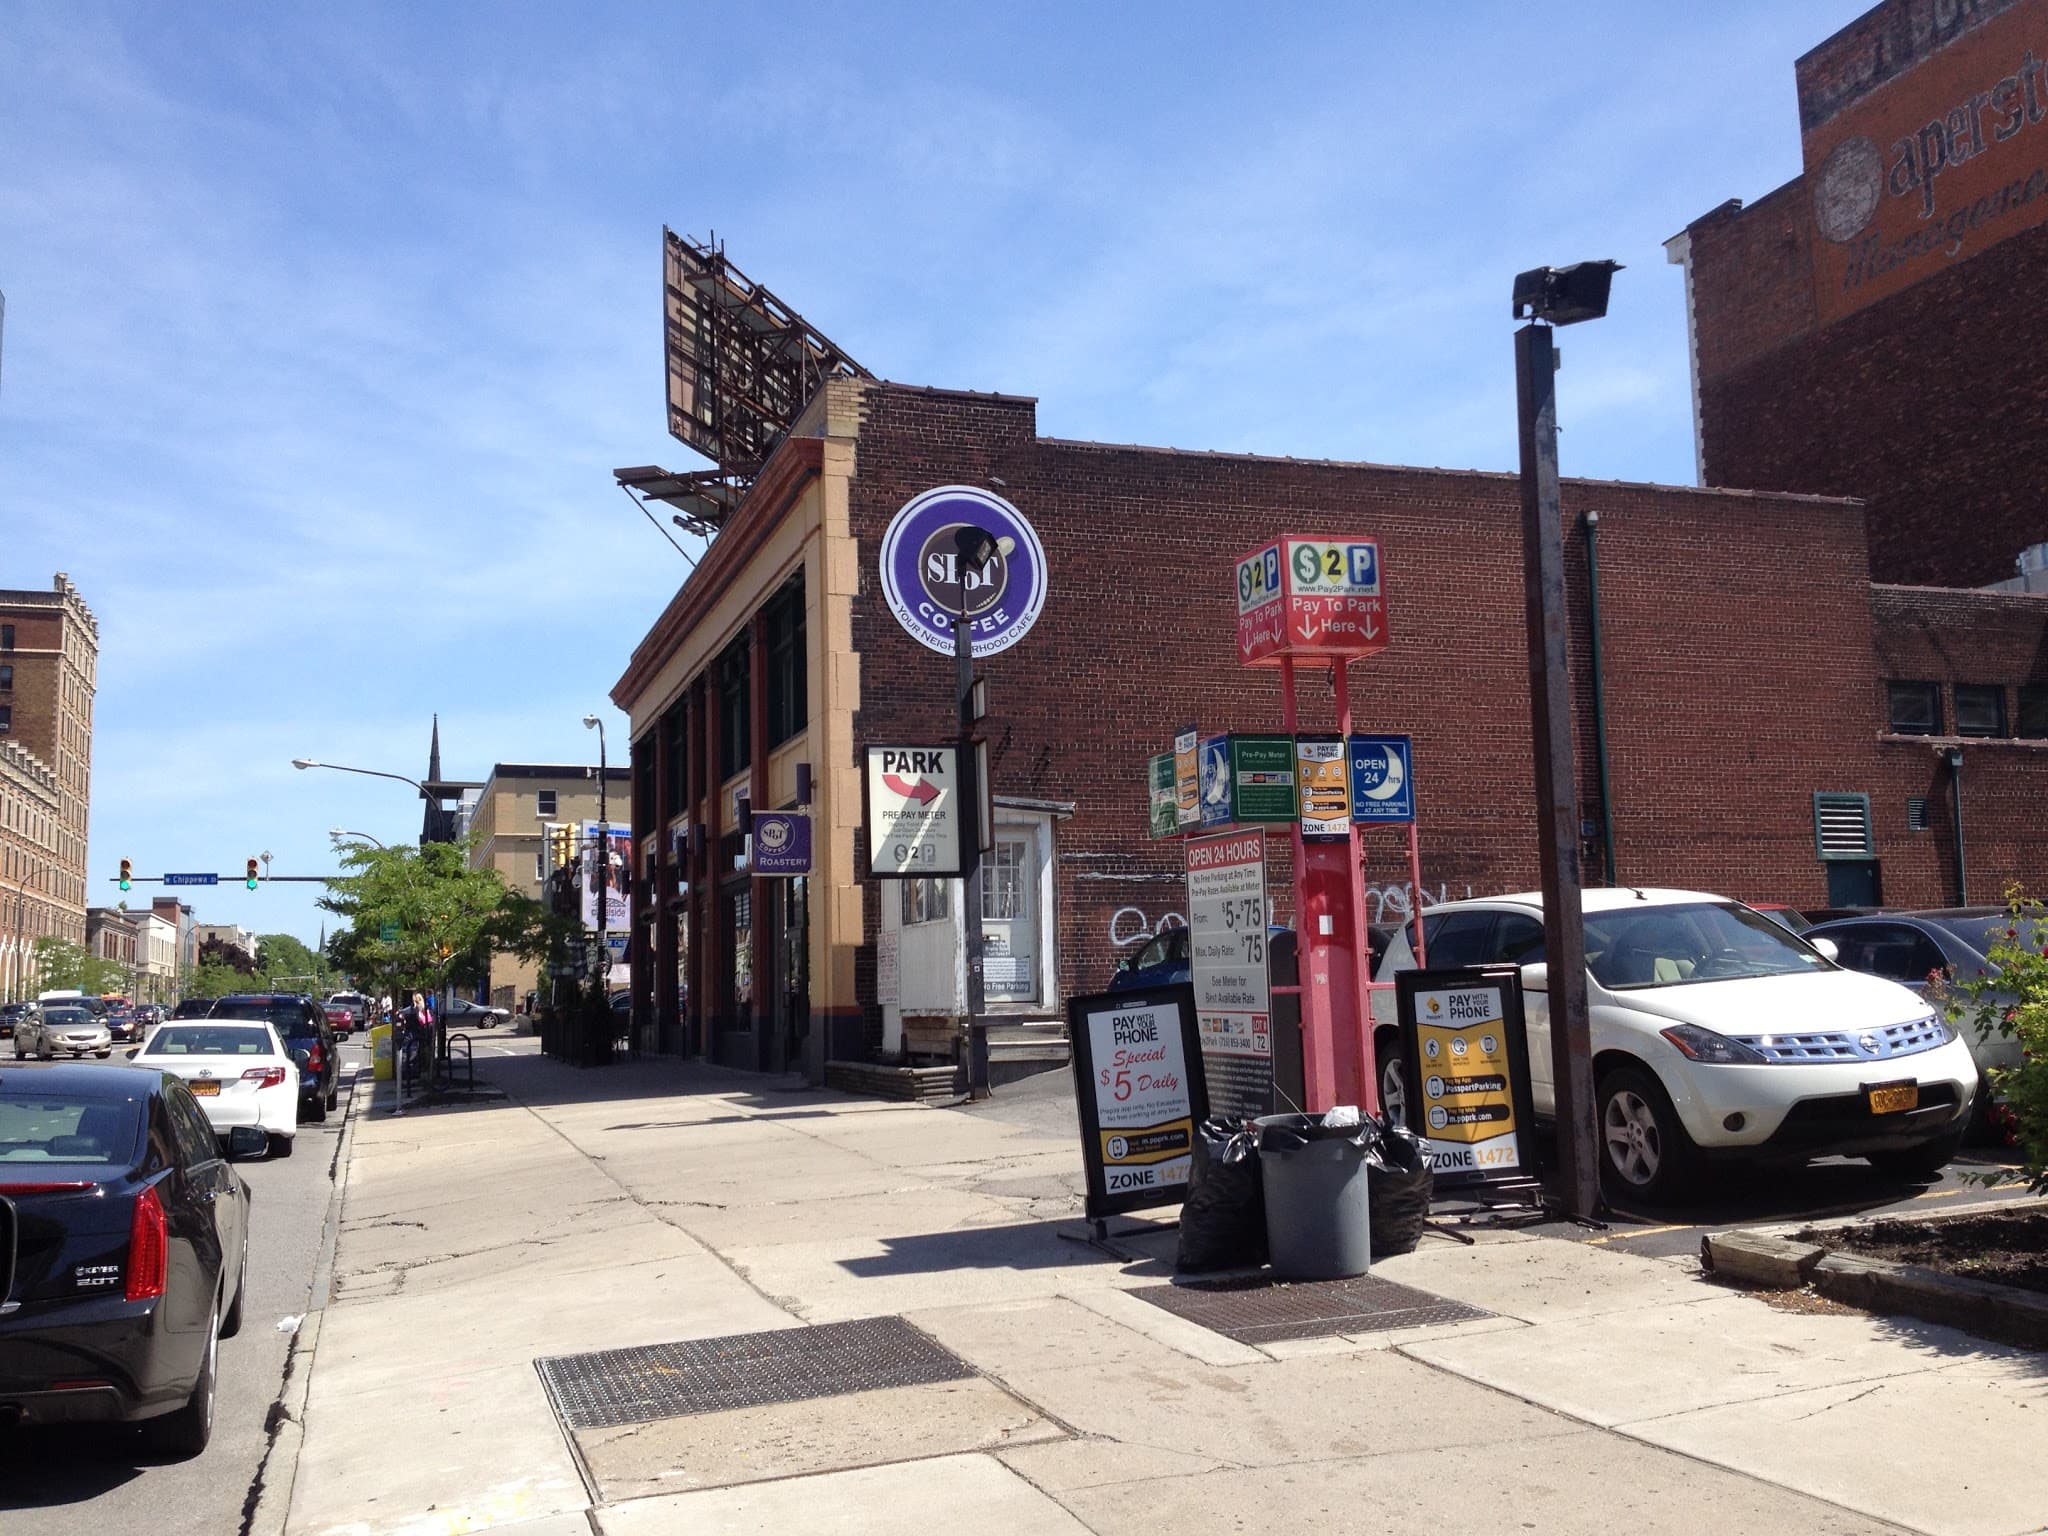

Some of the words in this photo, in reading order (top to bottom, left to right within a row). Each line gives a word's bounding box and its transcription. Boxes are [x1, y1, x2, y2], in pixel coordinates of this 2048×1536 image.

[1889, 50, 2048, 220] aperst
[1297, 584, 1375, 594] www.Pay2Park.net
[1292, 598, 1321, 615] Pay
[1325, 598, 1344, 612] To
[1347, 598, 1382, 612] Park
[1240, 616, 1253, 631] Pay
[1254, 610, 1264, 624] To
[1265, 600, 1283, 620] Park
[897, 605, 921, 634] YOUR
[920, 630, 1009, 654] NEIGHRHOOD
[1320, 618, 1356, 633] Here
[1253, 630, 1271, 646] Here
[882, 750, 945, 774] PARK
[1241, 751, 1267, 760] Pre-Pay
[1267, 751, 1286, 759] Meter
[1355, 759, 1387, 770] OPEN
[1364, 772, 1380, 784] 24
[1388, 775, 1401, 784] hrs
[882, 810, 900, 820] PRE
[901, 810, 917, 820] PAY
[917, 810, 947, 820] METER
[1303, 823, 1325, 833] ZONE
[1327, 823, 1347, 832] 1472
[1188, 846, 1213, 867] OPEN
[1214, 844, 1225, 864] 24
[1226, 839, 1260, 862] HOURS
[760, 857, 808, 866] ROASTERY
[172, 875, 208, 885] Chippewa
[1201, 874, 1210, 882] Free
[1210, 872, 1228, 882] Parking
[1234, 870, 1243, 880] Any
[1243, 868, 1257, 878] Time
[1246, 881, 1261, 891] Meter
[1207, 945, 1221, 959] Daily
[1241, 934, 1263, 964] $75
[991, 982, 1005, 991] Free
[1006, 982, 1029, 992] Parking
[1211, 975, 1221, 986] See
[1222, 975, 1238, 987] Meter
[1205, 992, 1217, 1004] Best
[1218, 992, 1242, 1004] Available
[1242, 993, 1255, 1005] Rate
[1448, 995, 1471, 1008] PAY
[1450, 1005, 1490, 1020] PHONE
[1112, 1015, 1136, 1032] PAY
[1136, 1013, 1154, 1023] WITH
[1136, 1020, 1155, 1029] YOUR
[1114, 1027, 1159, 1046] PHONE
[1256, 1034, 1266, 1049] 72
[1113, 1045, 1167, 1069] Special
[1137, 1071, 1179, 1092] Daily
[1445, 1081, 1502, 1094] PassportParking
[1128, 1111, 1150, 1119] parking
[1432, 1150, 1473, 1169] ZONE
[1476, 1146, 1515, 1165] 1472
[1109, 1170, 1155, 1190] ZONE
